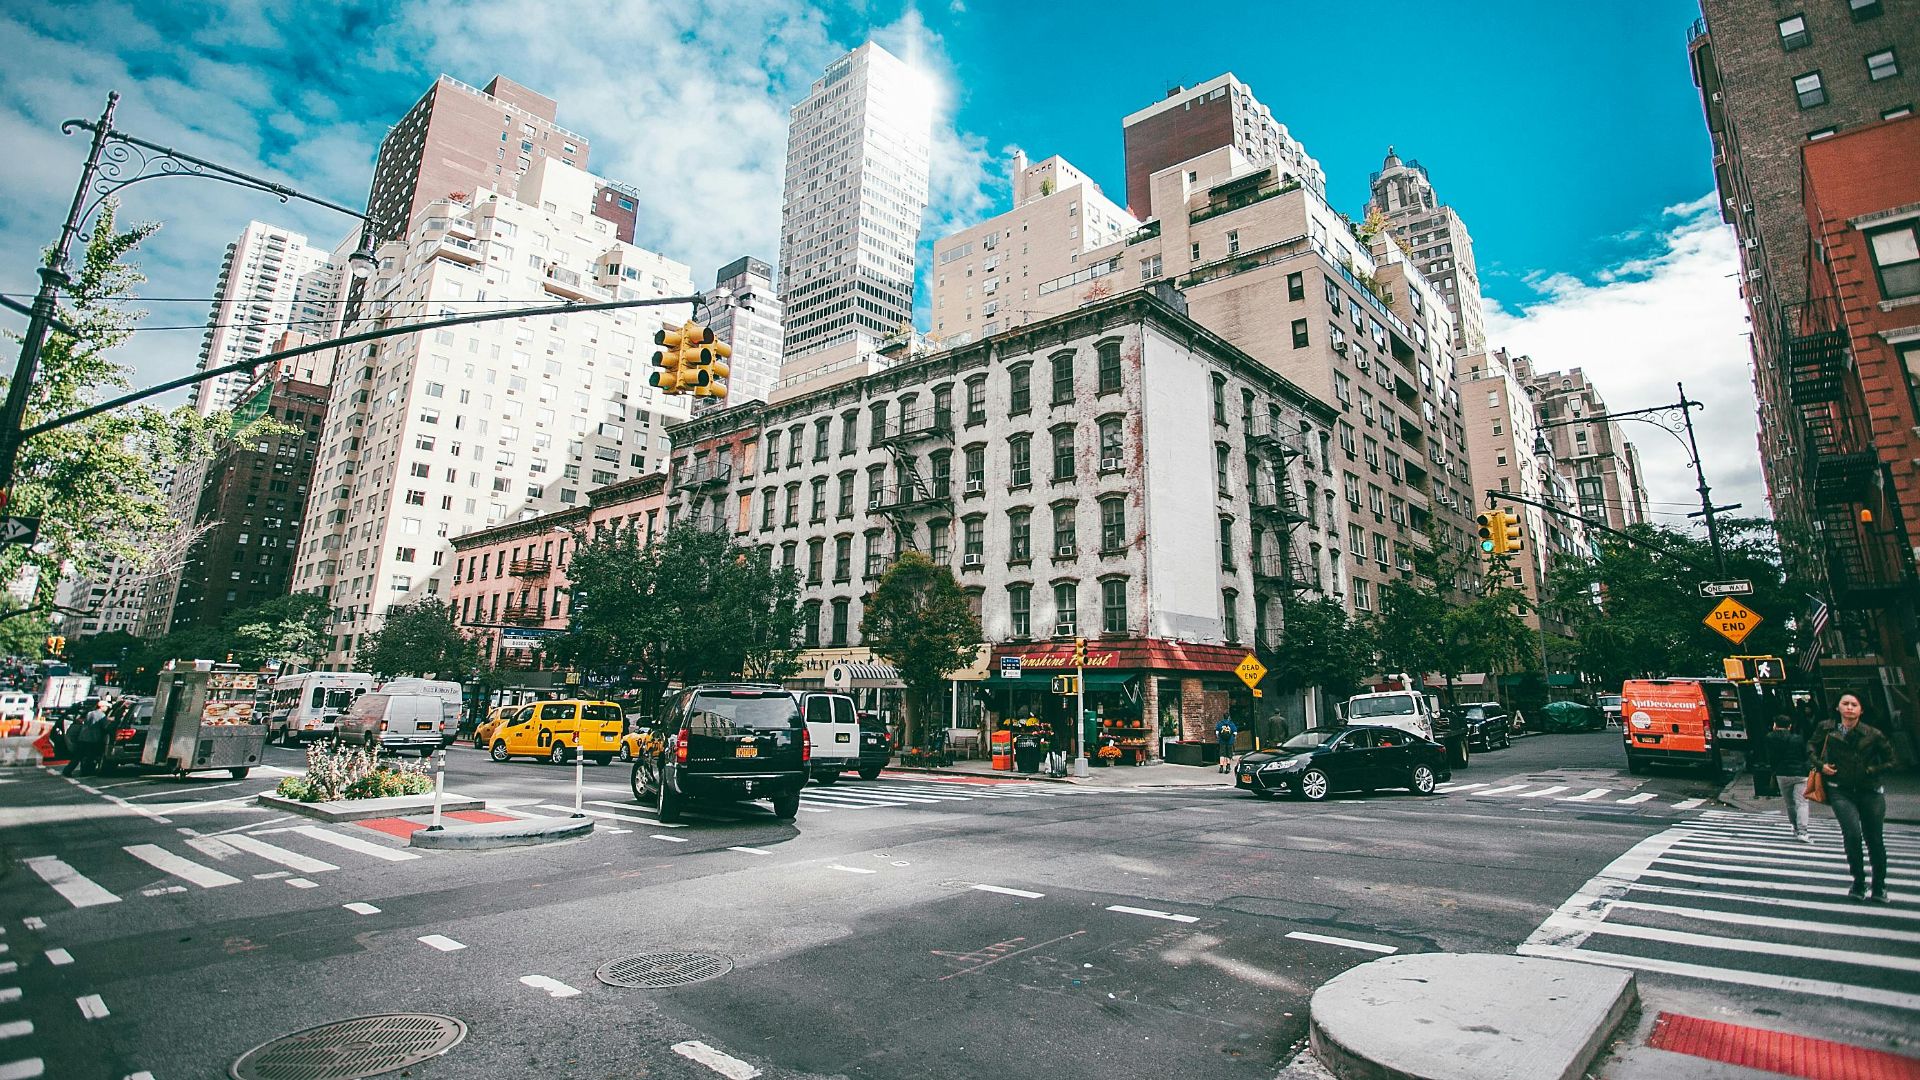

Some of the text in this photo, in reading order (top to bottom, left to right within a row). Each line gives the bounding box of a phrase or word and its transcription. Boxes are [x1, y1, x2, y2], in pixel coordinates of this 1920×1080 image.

[1707, 584, 1745, 593] ONE WAY
[1715, 609, 1748, 620] DEAD
[1722, 622, 1746, 632] END
[1017, 652, 1061, 667] Sunshine
[1062, 651, 1104, 666] Frist
[1631, 699, 1697, 709] AptDeco.com
